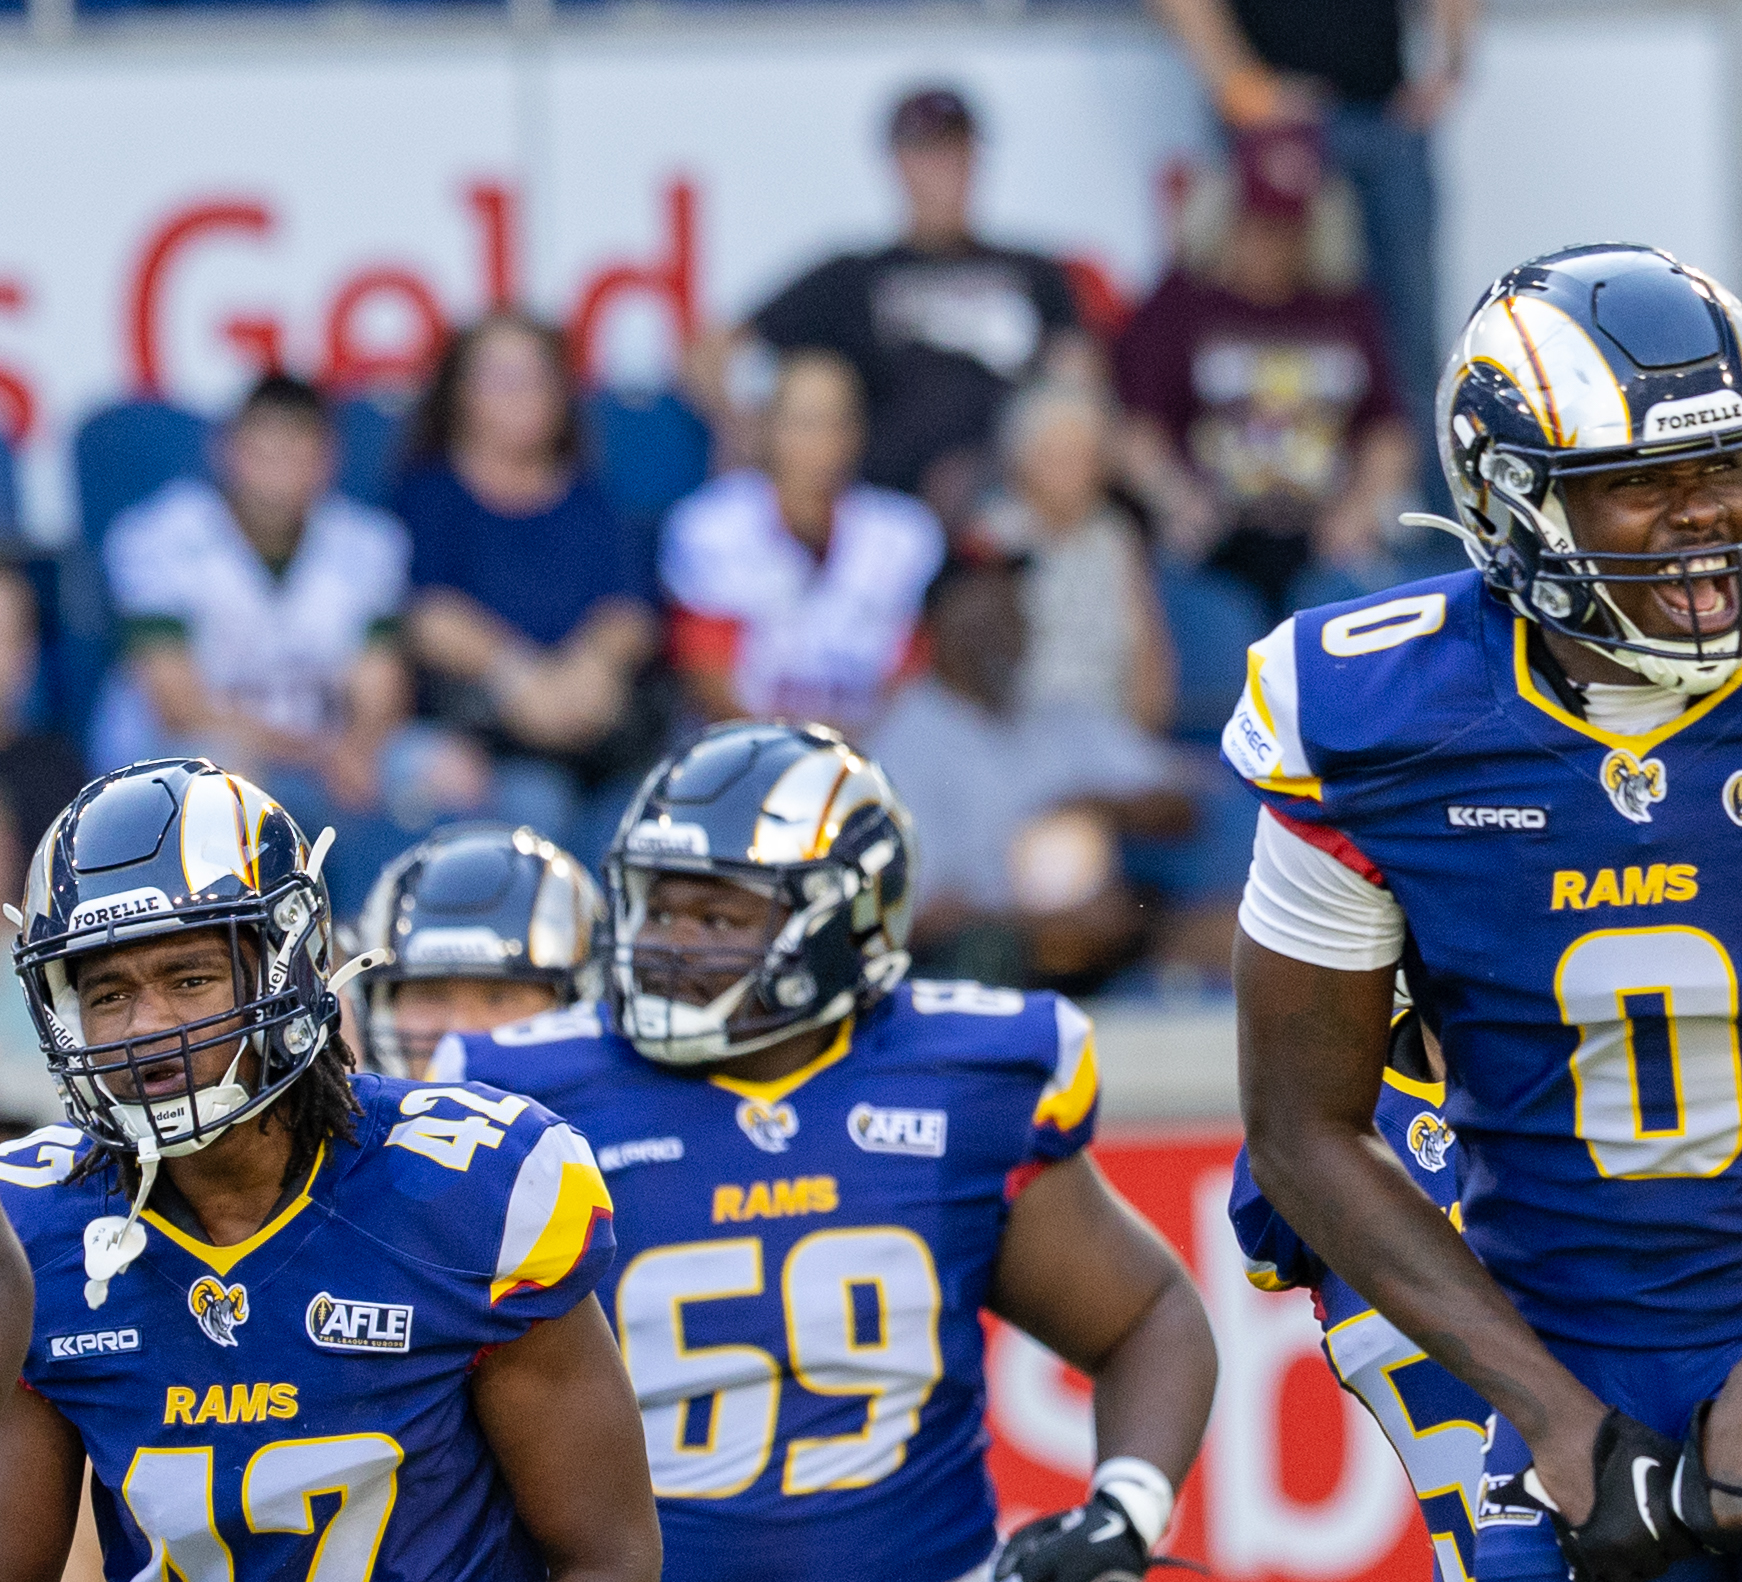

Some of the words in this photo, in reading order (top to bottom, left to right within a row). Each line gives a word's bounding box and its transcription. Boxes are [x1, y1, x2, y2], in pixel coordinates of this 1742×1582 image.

[1656, 404, 1742, 432] FORELLE
[1321, 593, 1446, 657] 0
[1551, 863, 1699, 911] RAMS
[74, 896, 160, 930] FORELLE
[383, 1087, 530, 1172] 42
[870, 1107, 939, 1150] AFLE
[713, 1174, 840, 1224] RAMS
[320, 1303, 407, 1341] AFLE
[615, 1224, 943, 1500] 69
[163, 1382, 298, 1425] RAMS
